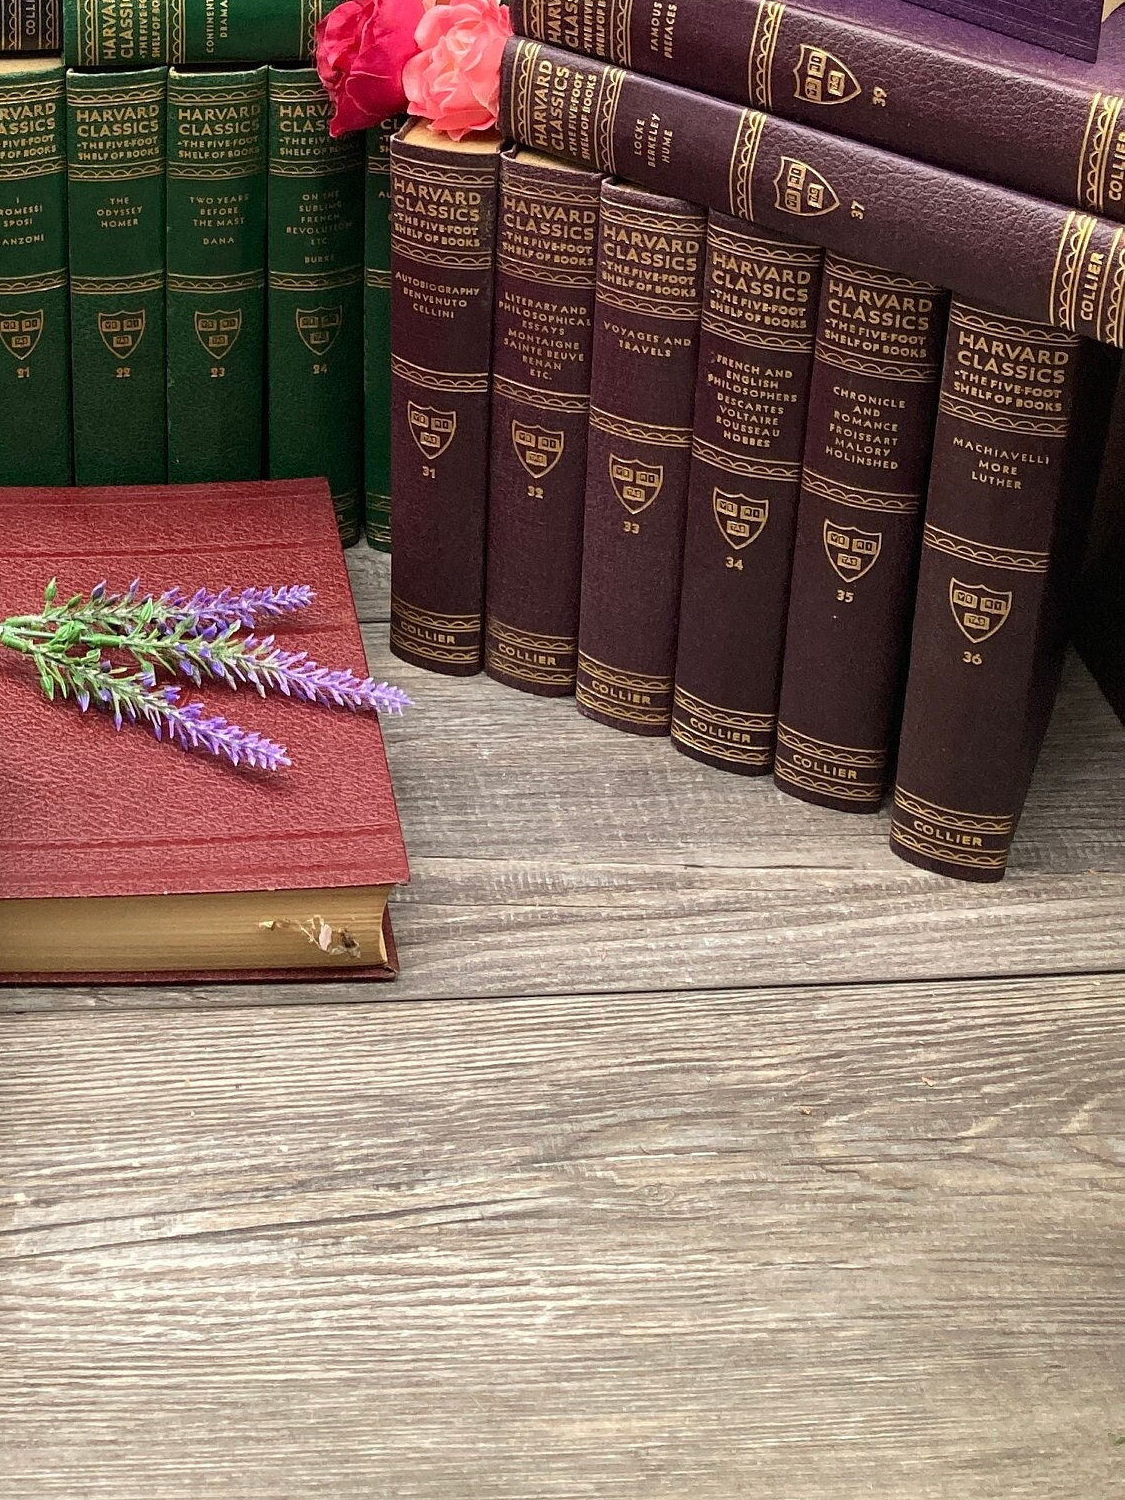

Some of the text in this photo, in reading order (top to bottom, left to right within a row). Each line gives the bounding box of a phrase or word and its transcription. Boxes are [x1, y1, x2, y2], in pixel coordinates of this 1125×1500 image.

[220, 0, 228, 38] DRAMA
[650, 1, 662, 51] FAMOUS
[533, 59, 553, 146] HARVARD
[551, 66, 571, 151] CLASSICS
[872, 88, 888, 107] 39
[76, 106, 159, 122] HARVARD
[178, 105, 261, 121] HARVARD
[77, 120, 159, 137] CLASSICS
[179, 120, 259, 136] CLASSICS
[634, 119, 645, 155] LOCKE
[661, 129, 673, 163] HUME
[394, 179, 481, 205] HARVARD
[97, 206, 143, 216] ODYSSEY
[394, 194, 480, 222] CLASSICS
[503, 196, 596, 224] HARVARD
[851, 201, 866, 220] 37
[101, 219, 139, 227] HOMER
[193, 217, 245, 227] THE MAST
[503, 215, 594, 240] CLASSICS
[202, 237, 235, 245] DANA
[603, 225, 699, 254] HARVARD
[603, 243, 697, 271] CLASSICS
[712, 252, 811, 285] HARVARD
[403, 287, 468, 307] BENVENUTO
[712, 270, 809, 302] CLASSICS
[829, 279, 932, 312] HARVARD
[1081, 253, 1104, 320] COLLIER
[413, 303, 455, 319] CELLINI
[504, 292, 559, 314] LITERARY
[828, 299, 929, 330] CLASSICS
[522, 320, 565, 336] ESSAYS
[604, 321, 691, 347] VOYAGES AND
[509, 329, 580, 350] MONTAIGNE
[618, 339, 671, 358] TRAVELS
[959, 331, 1069, 365] HARVARD
[546, 349, 584, 362] BEUVE
[717, 354, 793, 379] FRENCH AND
[530, 369, 552, 380] ETC.
[958, 351, 1065, 384] CLASSICS
[727, 370, 779, 389] ENGLISH
[989, 378, 1061, 399] FIVE-FOOT
[717, 392, 784, 414] DESCARTES
[833, 386, 906, 409] CHRONICLE
[1017, 397, 1062, 413] BOOKS
[720, 405, 779, 426] VOLTAIRE
[833, 411, 899, 432] ROMANCE
[853, 405, 881, 417] AND
[716, 416, 780, 437] ROUSSEAU
[829, 424, 898, 446] FROISSART
[825, 446, 898, 470] HOLINSHED
[835, 438, 890, 457] MALORY
[953, 437, 1050, 465] MACHIAVELLI
[422, 465, 436, 478] 31
[979, 460, 1018, 475] MORE
[971, 471, 1022, 490] LUTHER
[725, 557, 744, 570] 34
[836, 589, 854, 603] 35
[401, 621, 456, 644] COLLIER
[499, 643, 557, 666] COLLIER
[962, 651, 982, 665] 36
[592, 678, 651, 704] COLLIER
[689, 717, 751, 744] COLLIER
[792, 753, 857, 780] COLLIER
[914, 819, 983, 846] COLLIER
